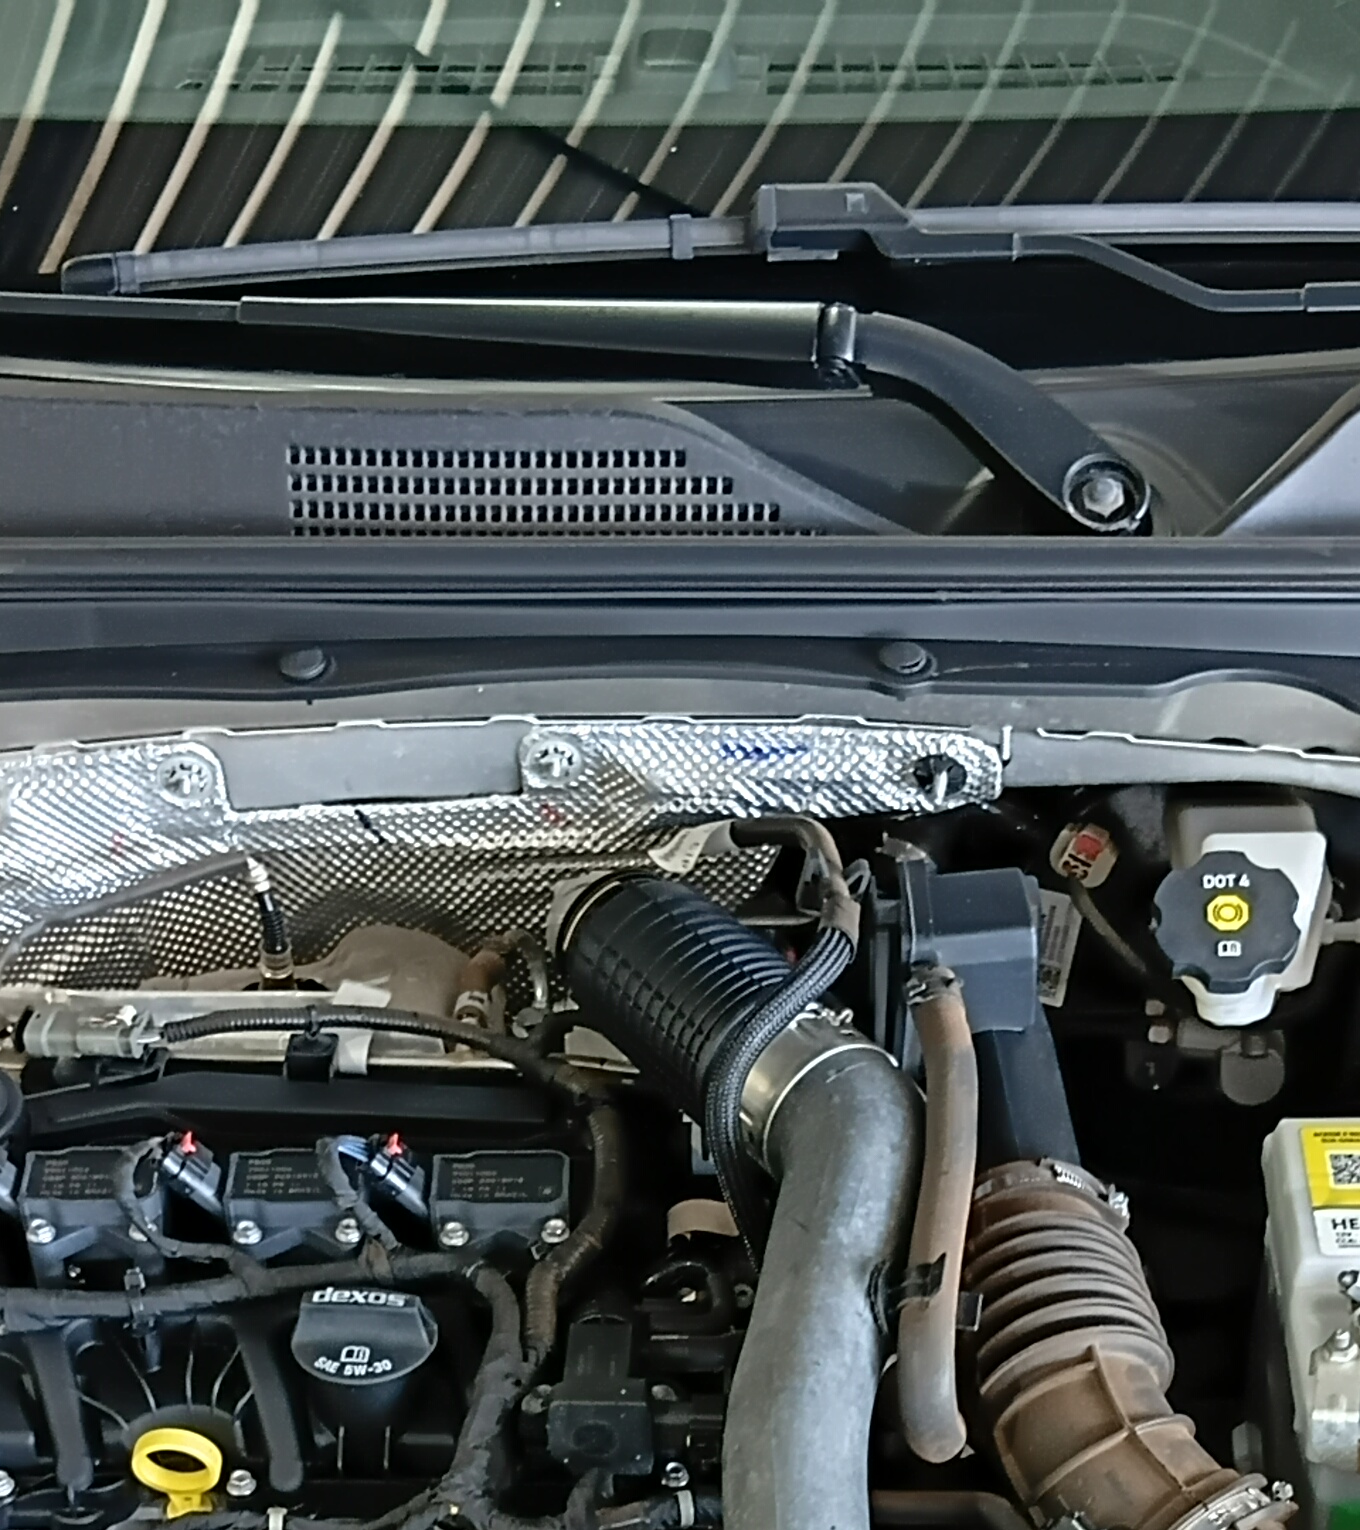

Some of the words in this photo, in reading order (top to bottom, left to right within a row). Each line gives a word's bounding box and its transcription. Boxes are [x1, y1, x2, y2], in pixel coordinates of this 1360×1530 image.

[1202, 874, 1237, 889] DOT
[1238, 873, 1251, 888] 4
[312, 1286, 406, 1307] dexos
[313, 1356, 341, 1374] SAE
[343, 1358, 393, 1377] 5W-30
